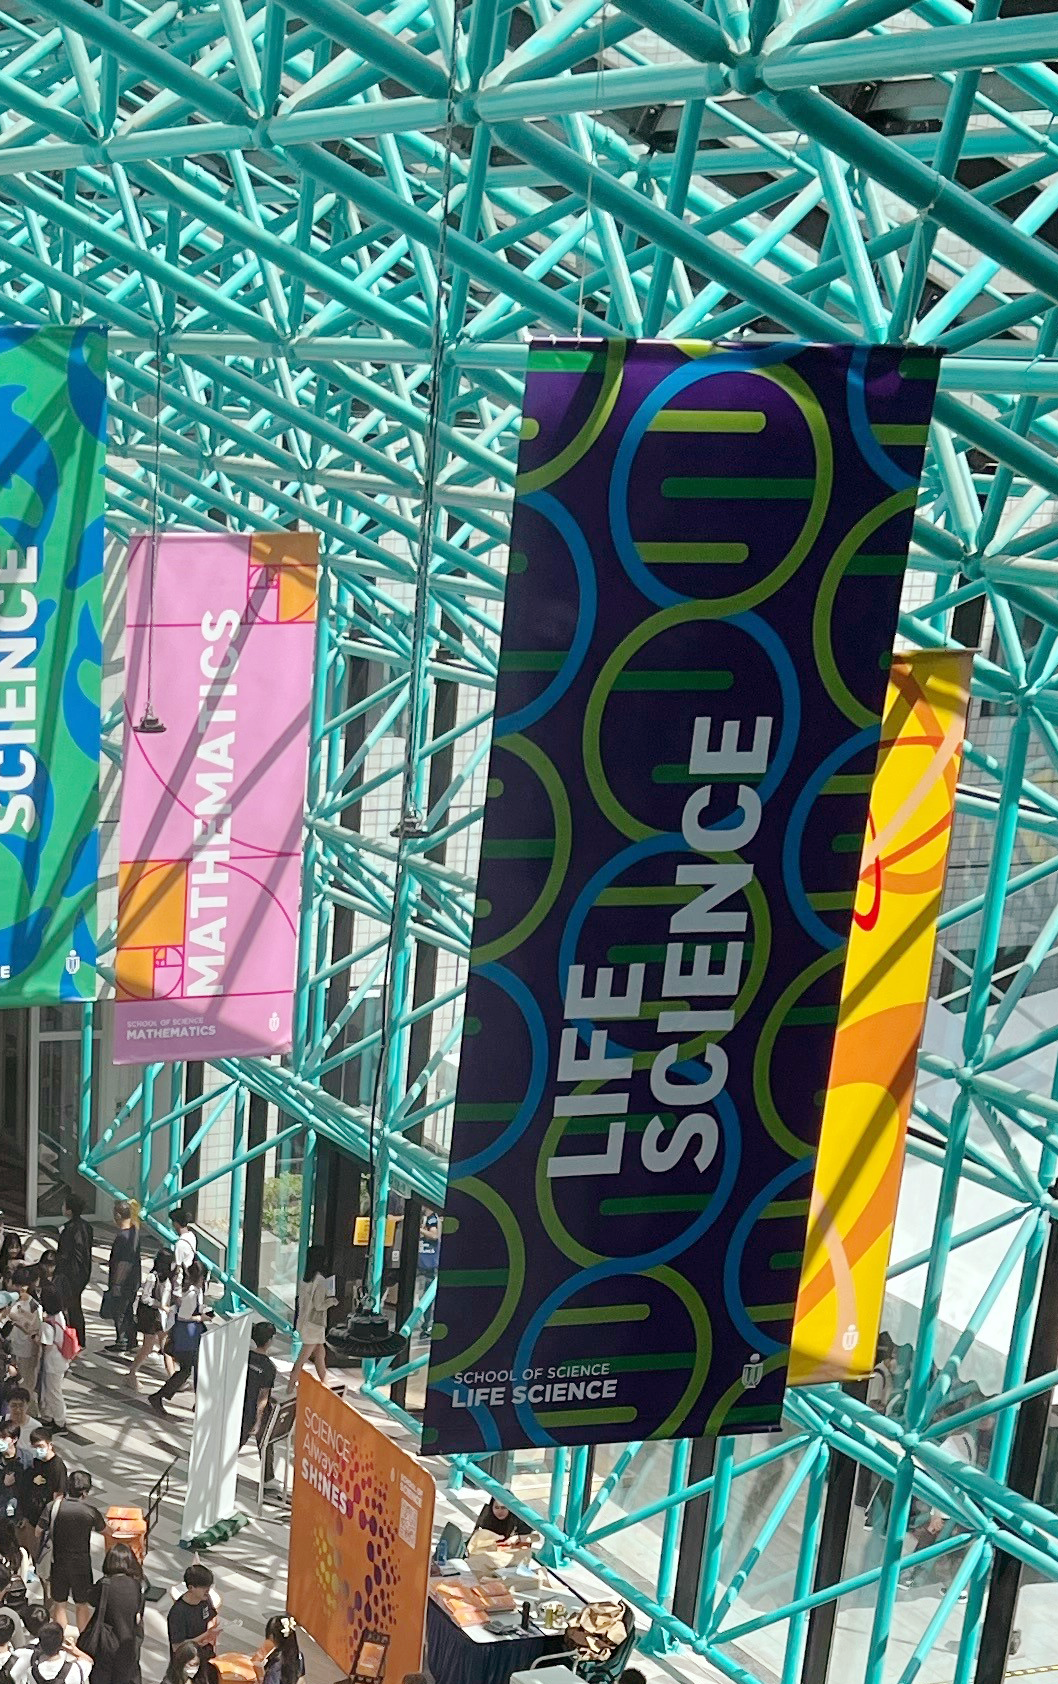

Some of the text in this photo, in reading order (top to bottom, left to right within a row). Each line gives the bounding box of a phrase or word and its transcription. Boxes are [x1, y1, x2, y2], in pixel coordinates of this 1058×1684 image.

[185, 608, 241, 997] MATHEMATICS
[641, 715, 774, 1174] SCIENCE
[126, 1024, 217, 1041] MATHEMATICS
[546, 961, 644, 1178] LIFE
[451, 1379, 618, 1408] LIFE SCIENCE
[454, 1363, 611, 1384] SCHOOL OF SCIENCE
[302, 1433, 340, 1480] Always
[304, 1406, 352, 1463] SCIENCE
